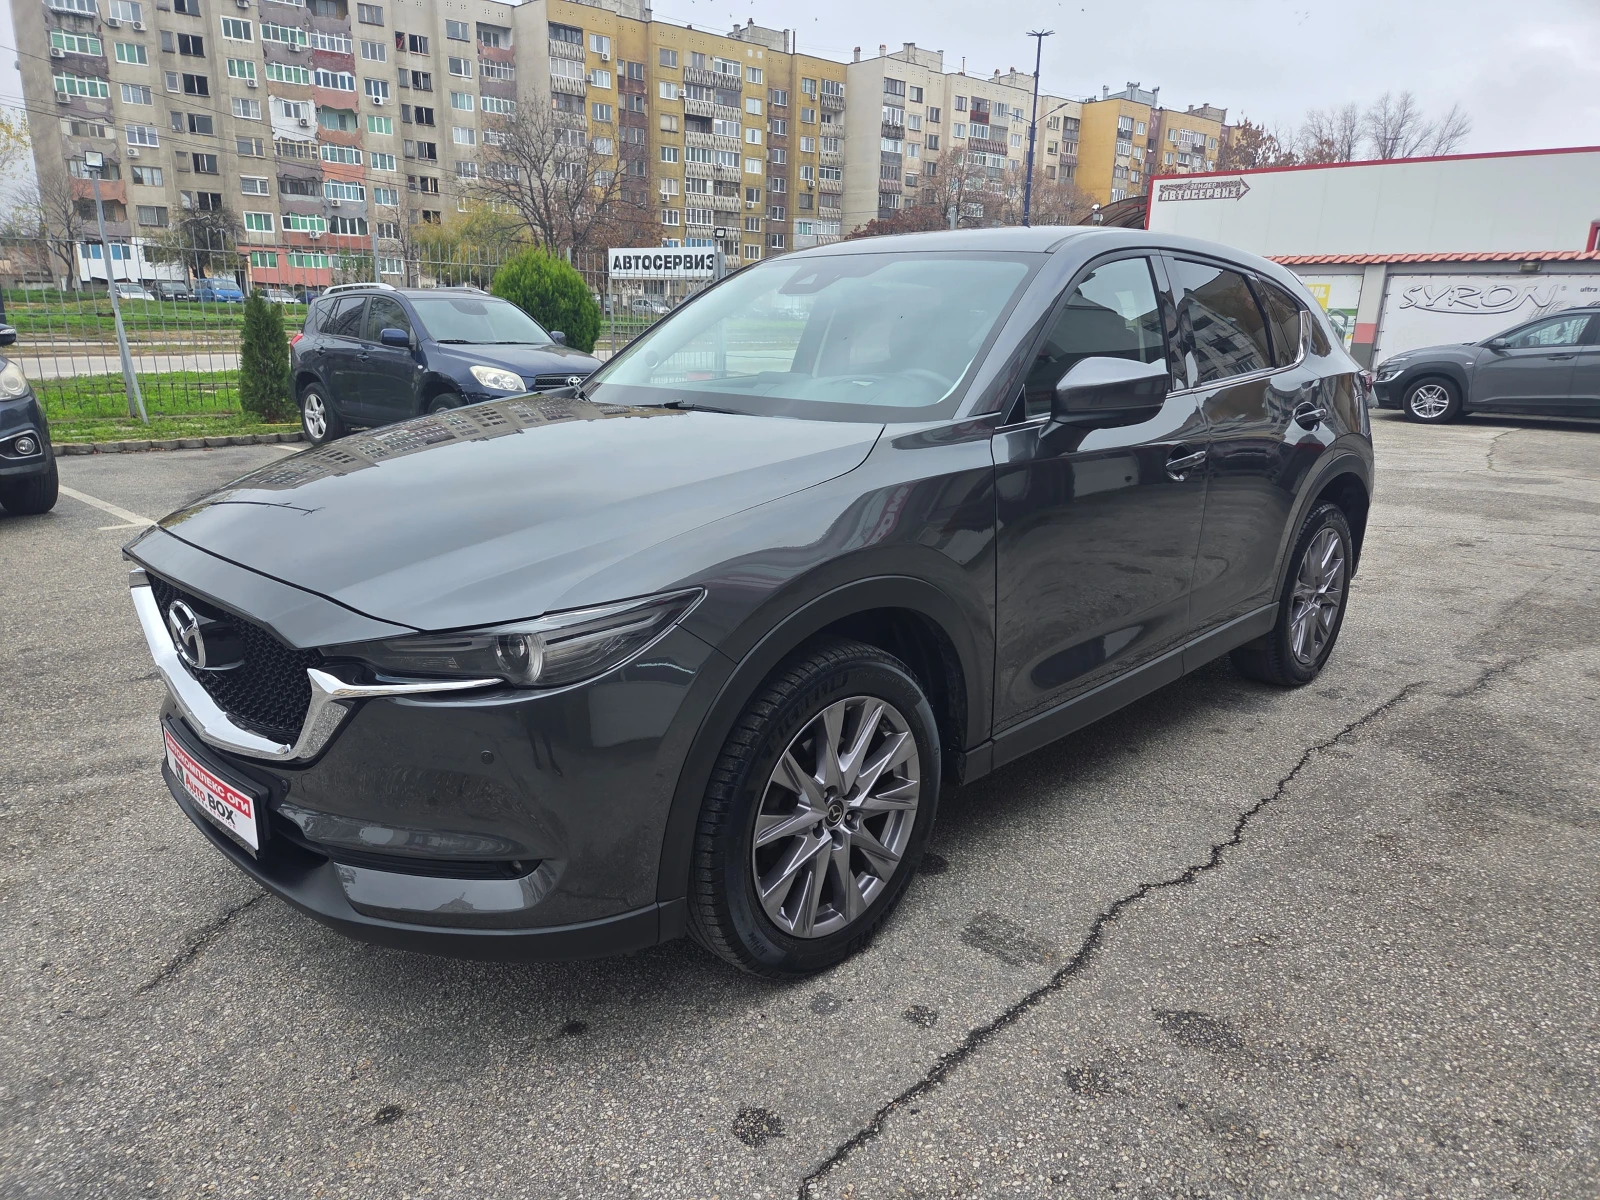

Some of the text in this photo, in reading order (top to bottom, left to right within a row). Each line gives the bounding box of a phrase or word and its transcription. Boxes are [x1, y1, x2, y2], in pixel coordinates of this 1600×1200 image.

[1161, 187, 1237, 200] АВТОСЕРВИЗ
[613, 254, 714, 270] АВТОСЕРВИЗ
[1400, 284, 1559, 310] SYRON
[207, 792, 236, 825] BOX
[227, 792, 249, 814] ОГИ
